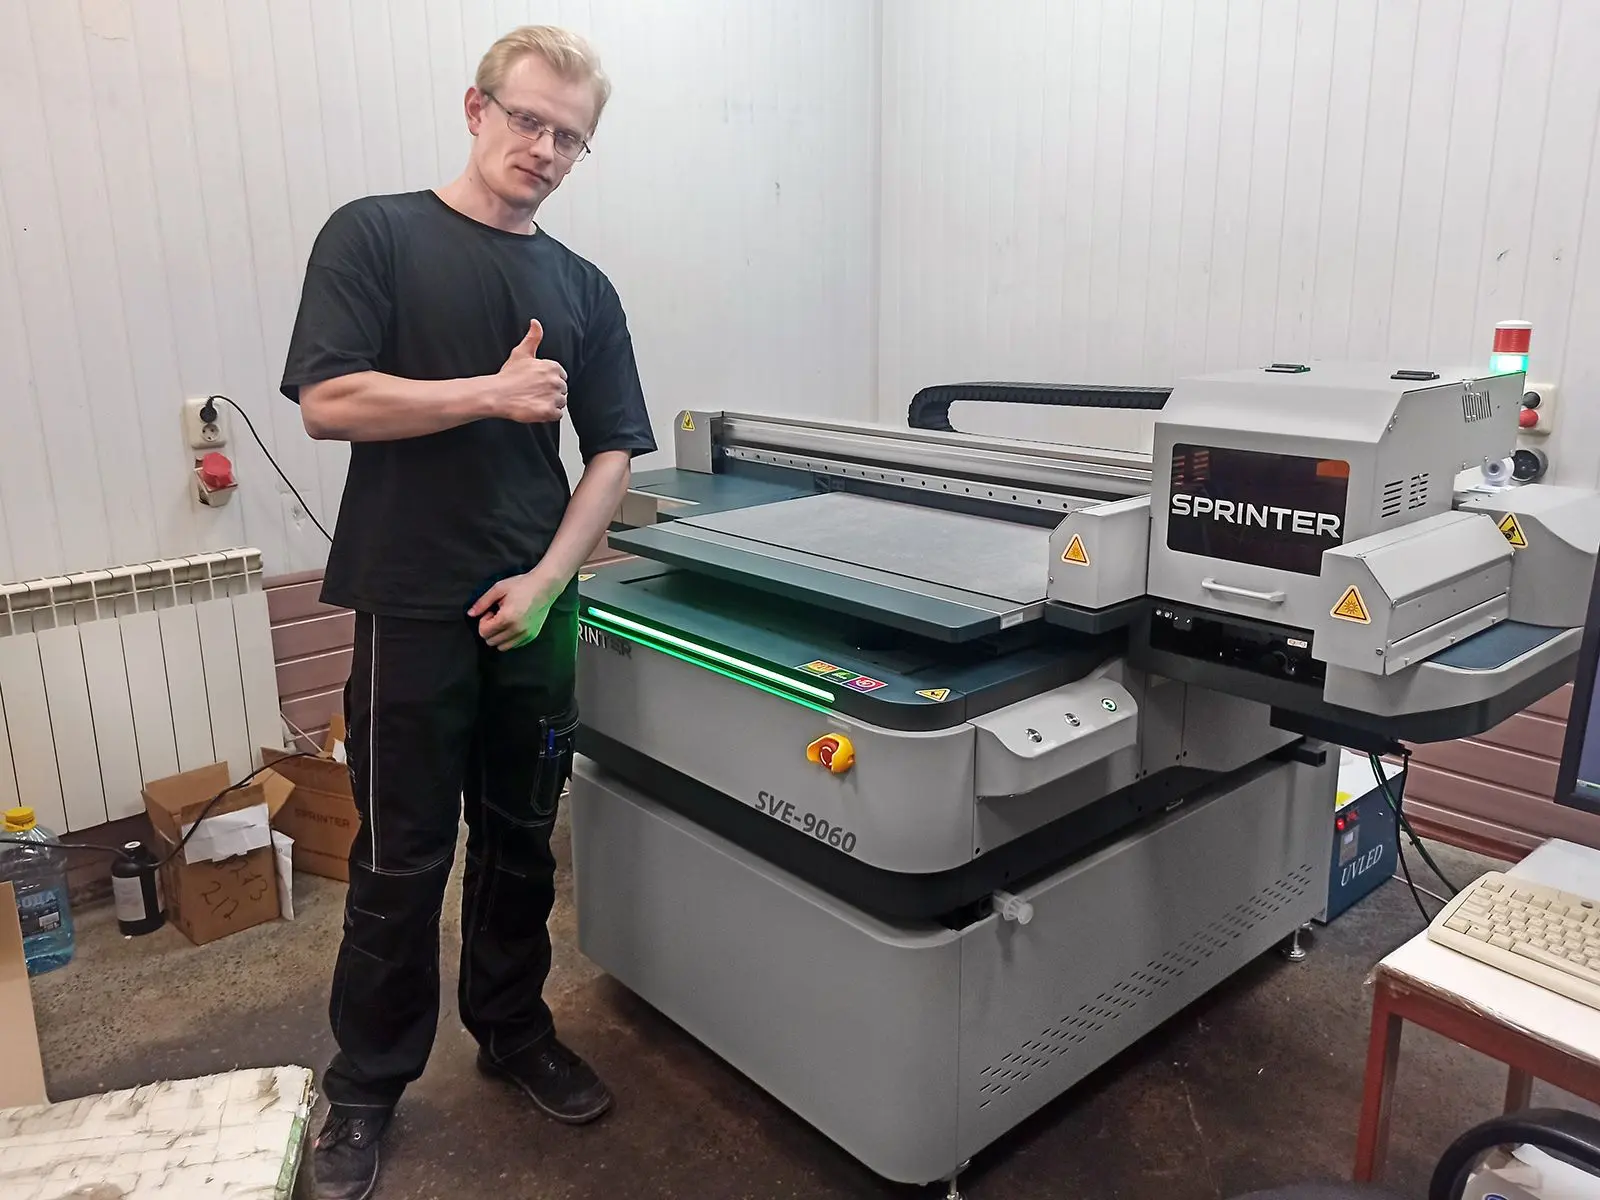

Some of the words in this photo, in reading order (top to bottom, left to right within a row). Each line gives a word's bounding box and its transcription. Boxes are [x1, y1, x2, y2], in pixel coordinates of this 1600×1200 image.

[1171, 493, 1341, 539] SPRINTER
[578, 623, 633, 660] RINTER
[754, 790, 857, 853] SVE-9060
[1341, 844, 1383, 887] UVLED
